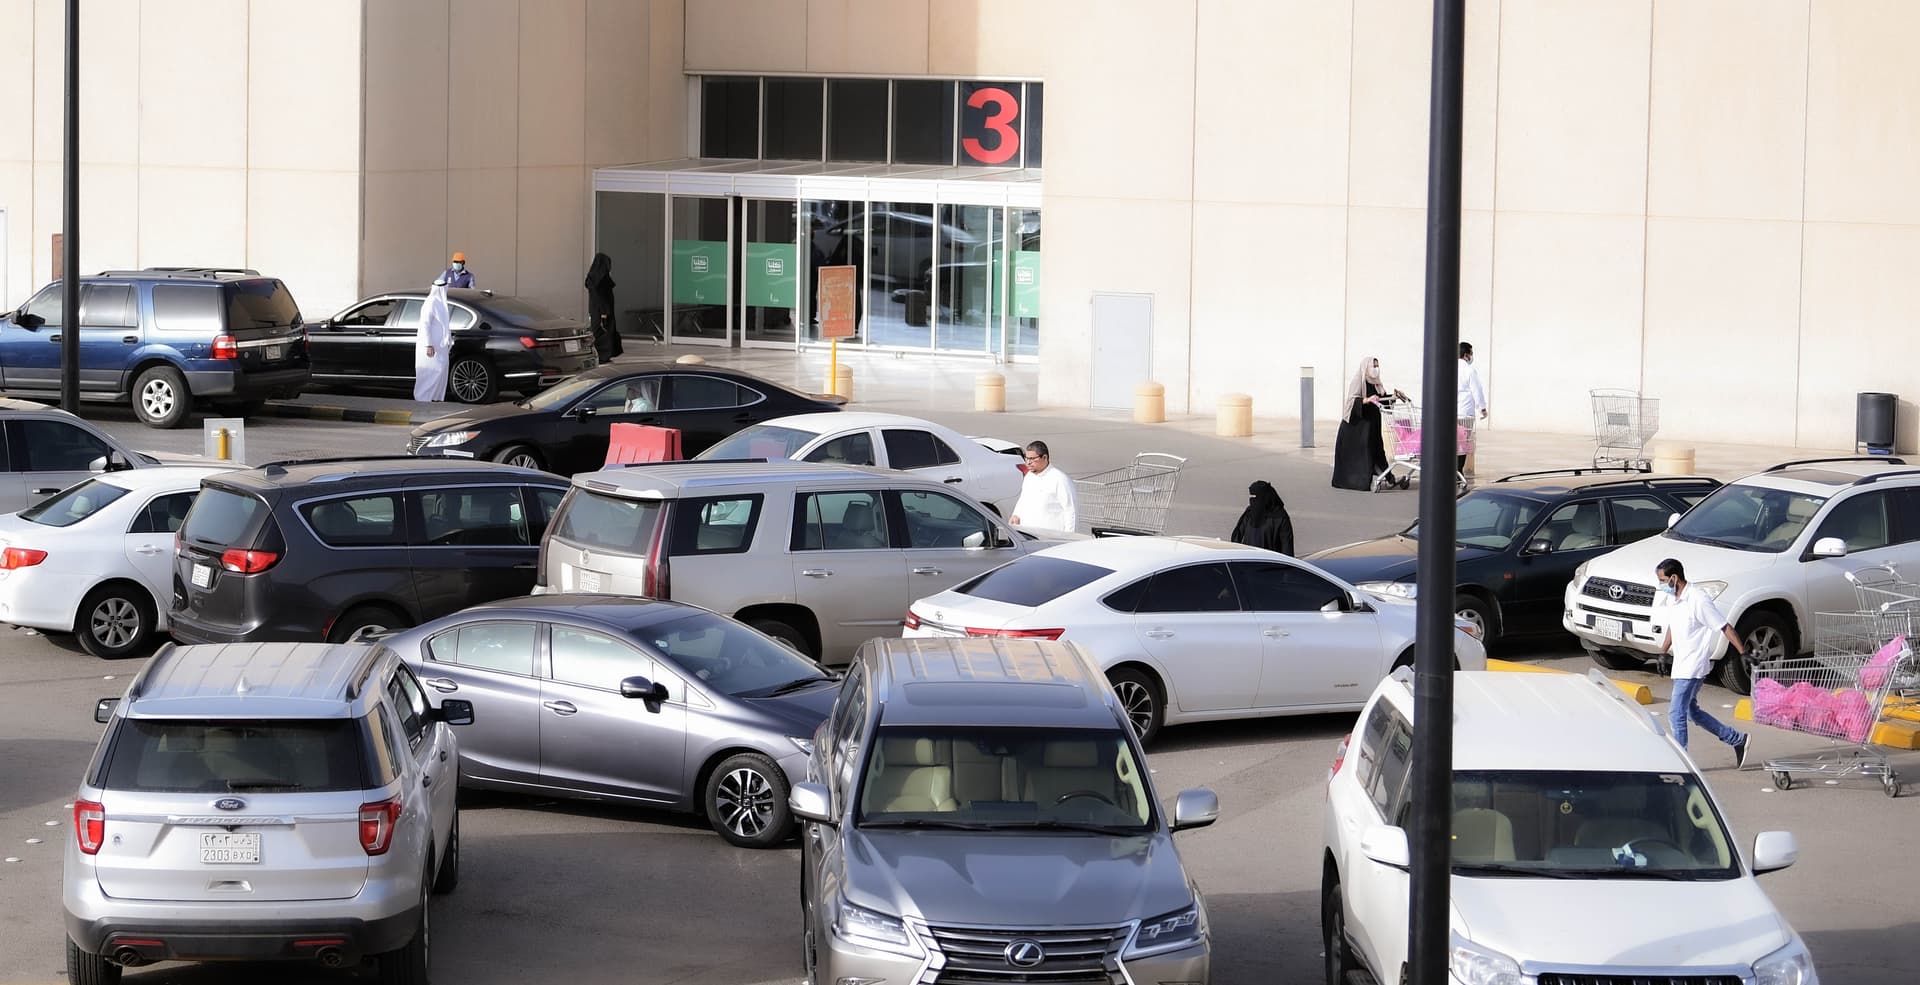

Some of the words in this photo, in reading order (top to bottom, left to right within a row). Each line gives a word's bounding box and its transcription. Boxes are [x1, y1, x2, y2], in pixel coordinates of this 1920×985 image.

[962, 87, 1020, 164] 3
[220, 800, 239, 809] Ford
[203, 849, 230, 861] 2303
